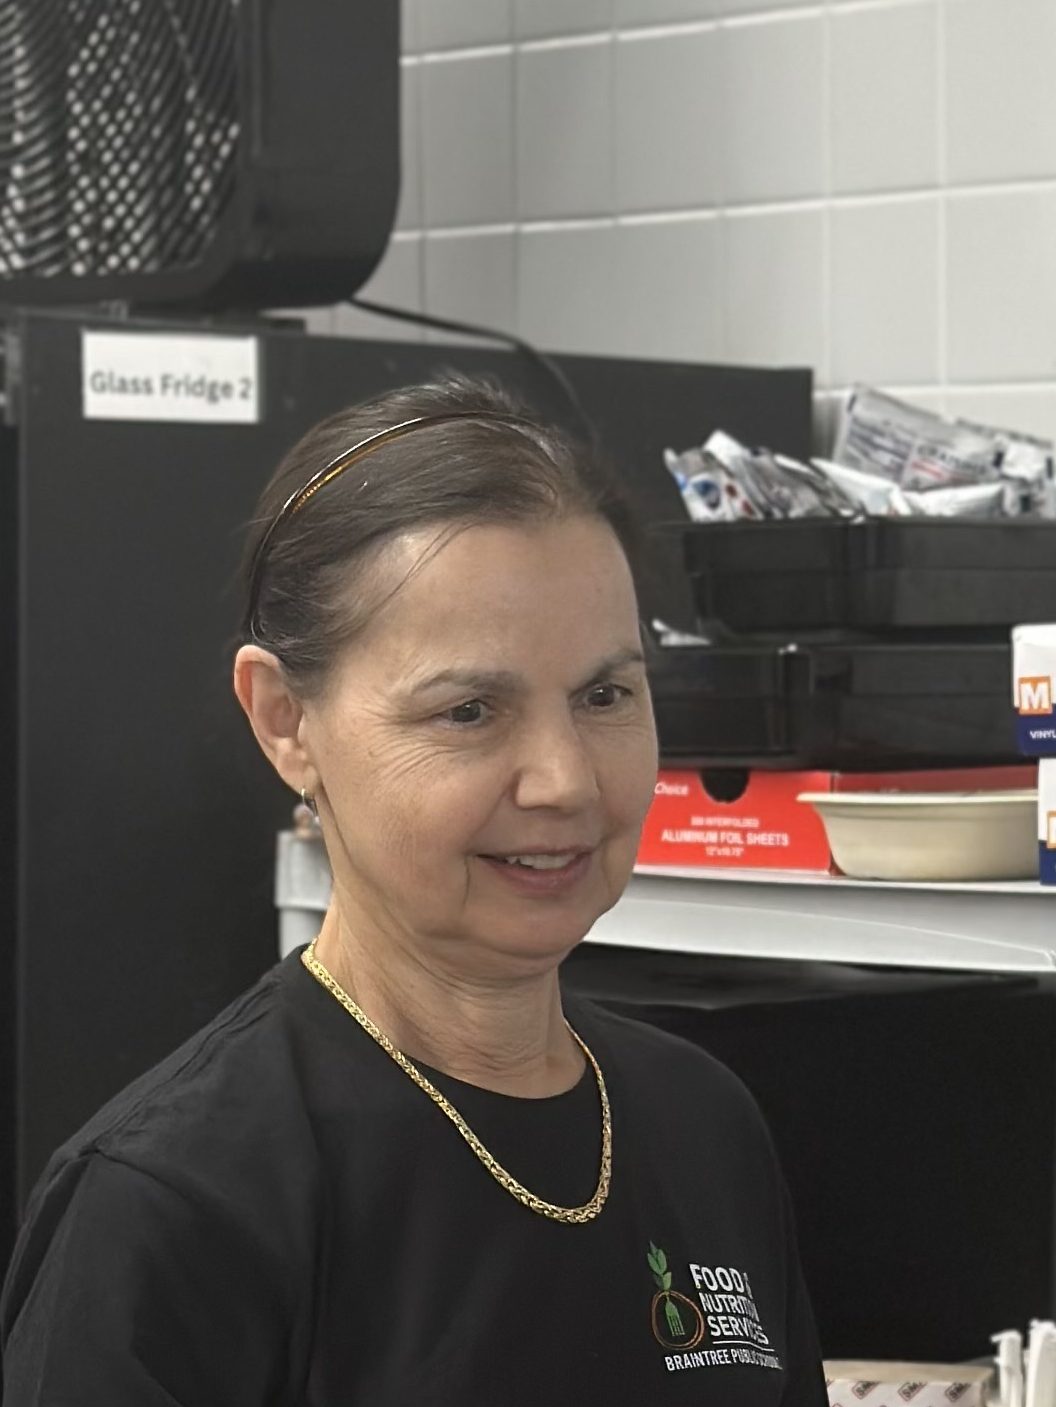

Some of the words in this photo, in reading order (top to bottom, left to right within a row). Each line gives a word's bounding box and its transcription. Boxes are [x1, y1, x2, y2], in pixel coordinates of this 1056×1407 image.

[90, 370, 154, 395] Glass
[160, 374, 235, 405] Fridge
[239, 377, 253, 400] 2
[1019, 682, 1050, 711] M
[654, 781, 689, 796] Choice
[661, 829, 718, 844] ALUMINUM
[719, 831, 744, 845] FOIL
[746, 832, 790, 847] SHEETS
[689, 1263, 745, 1293] FOOD
[699, 1292, 760, 1322] NUTRIT
[707, 1315, 769, 1345] SERVS
[664, 1349, 732, 1371] BRAINTREE
